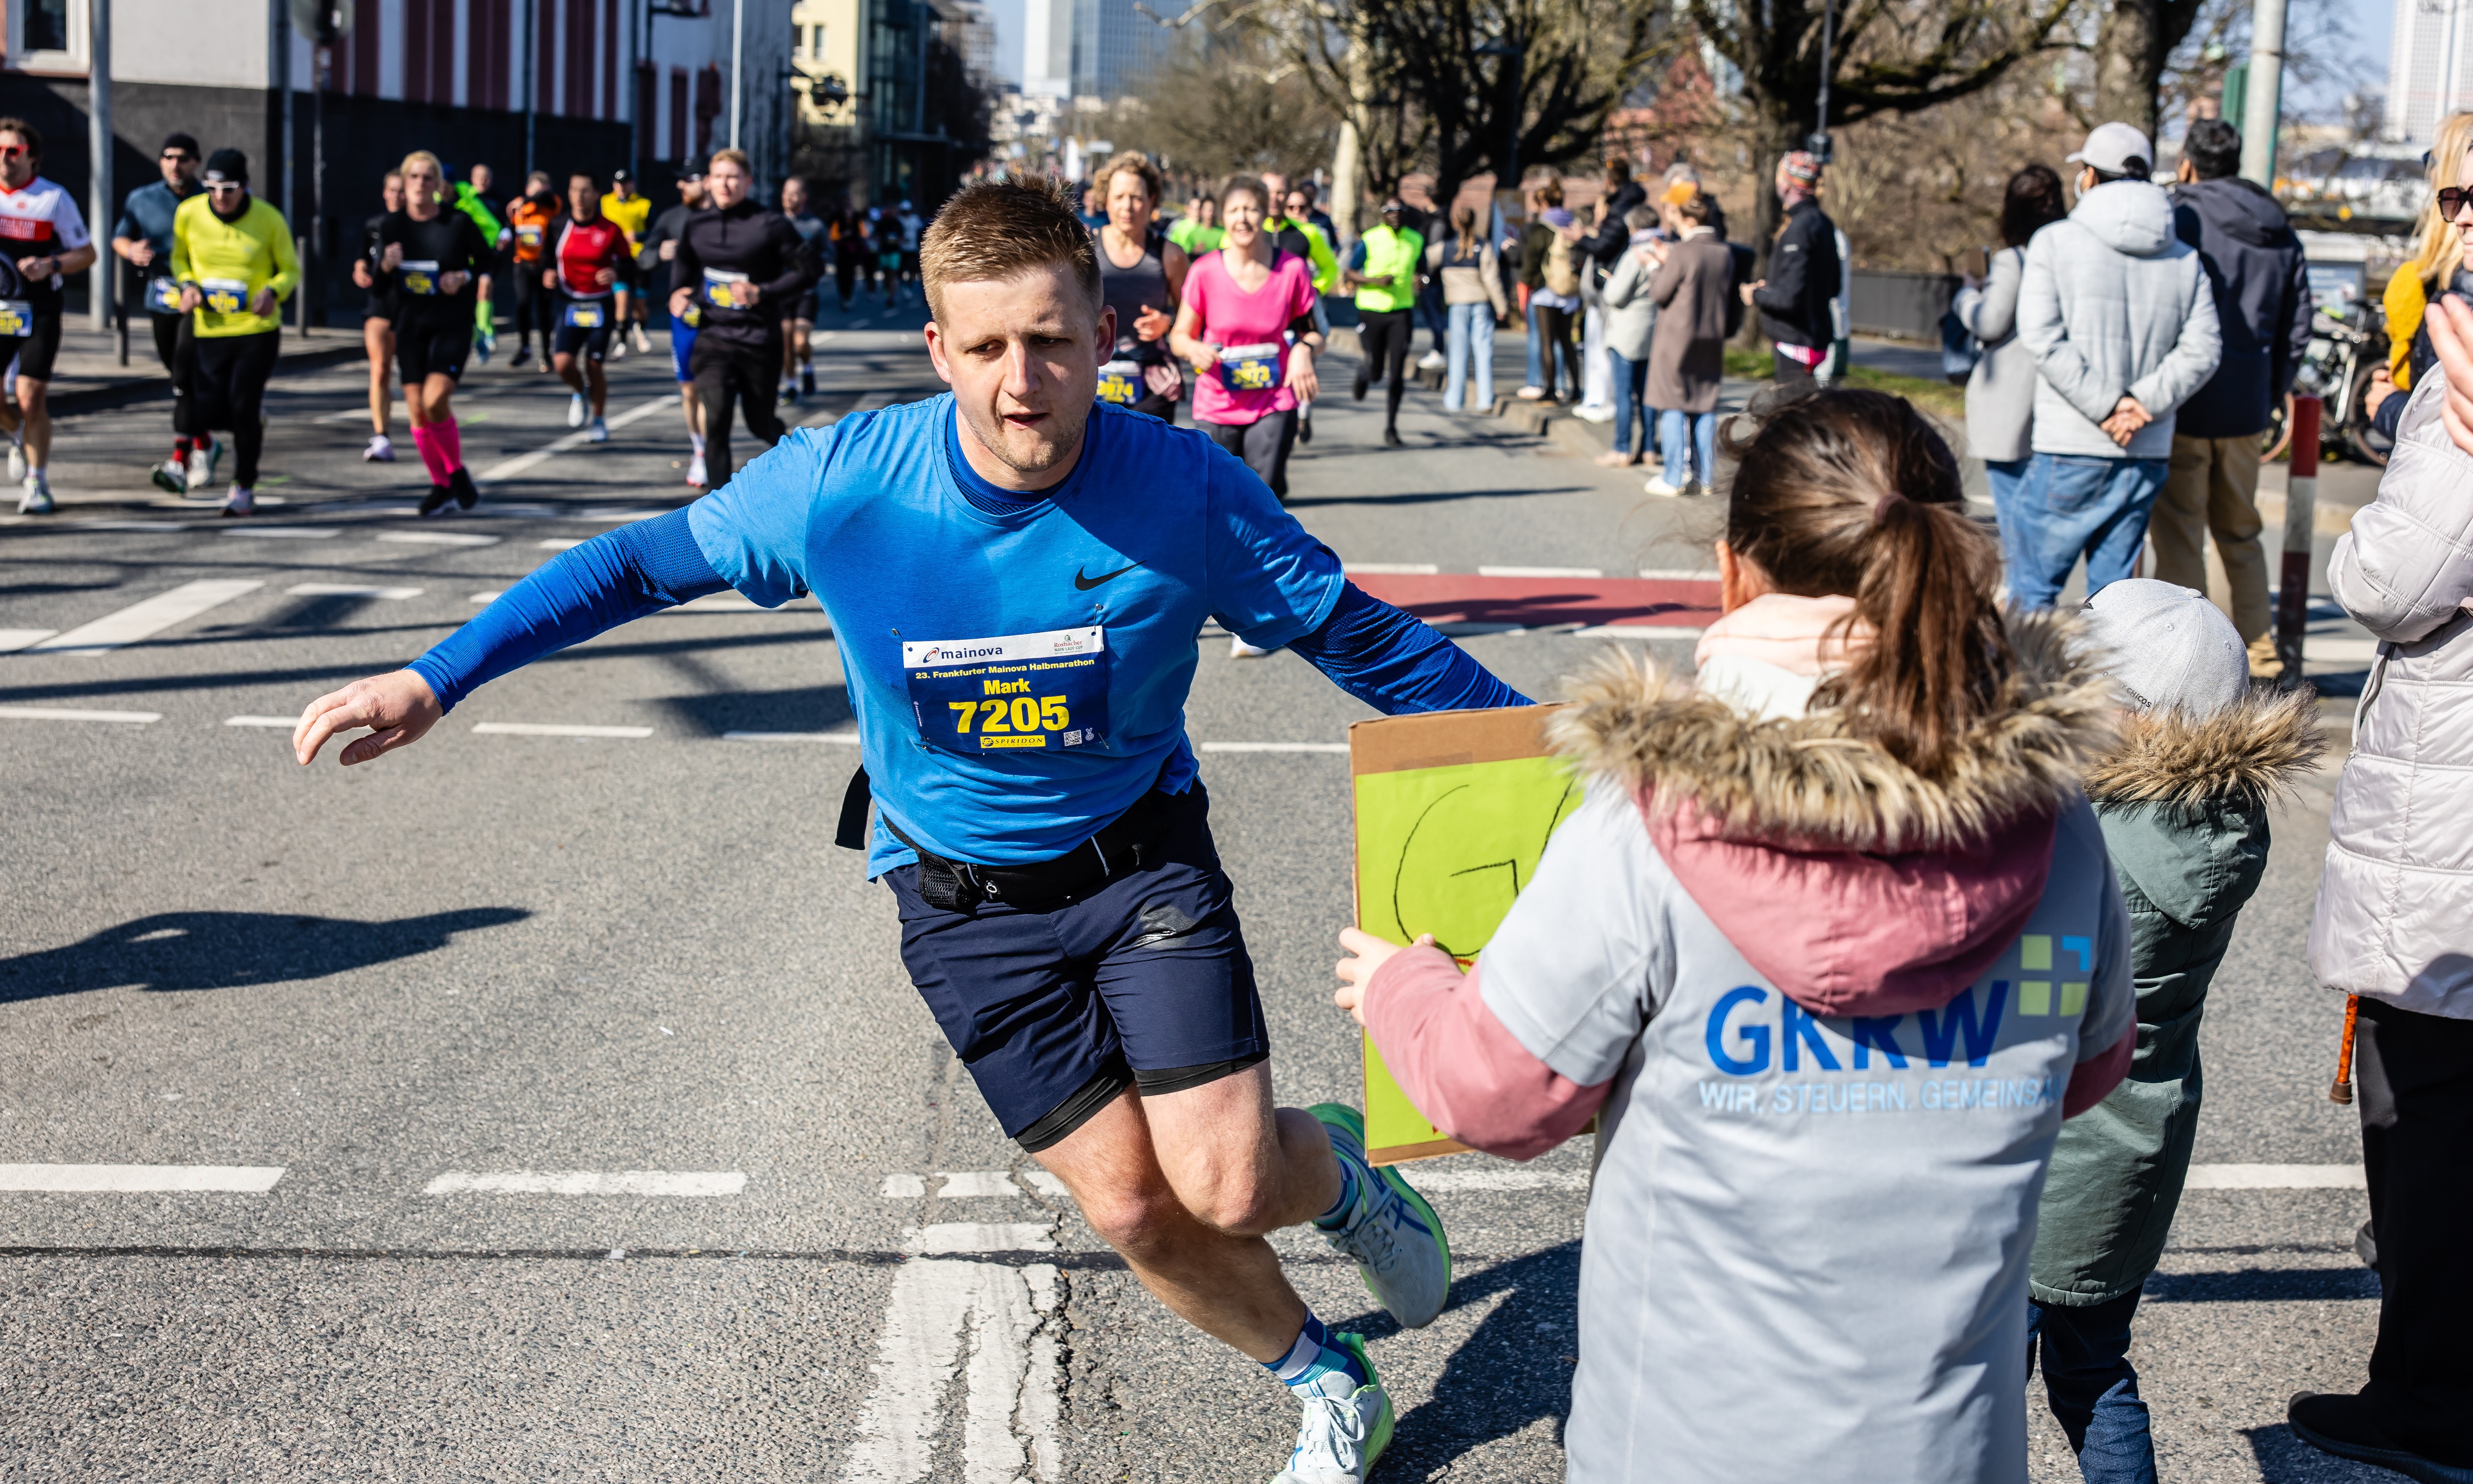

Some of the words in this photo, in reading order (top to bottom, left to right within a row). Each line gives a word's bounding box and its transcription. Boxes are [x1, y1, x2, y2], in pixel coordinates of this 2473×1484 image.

[941, 647, 1003, 659] mainova
[933, 668, 986, 678] Frankfurter
[988, 665, 1027, 673] Mainova
[1030, 659, 1095, 670] Halbmarathon
[984, 678, 1031, 695] Mark
[2126, 687, 2152, 707] CHICOS
[949, 695, 1069, 733] 7205
[1698, 1080, 1764, 1114] WIR.
[1773, 1081, 1912, 1114] STEUERN.
